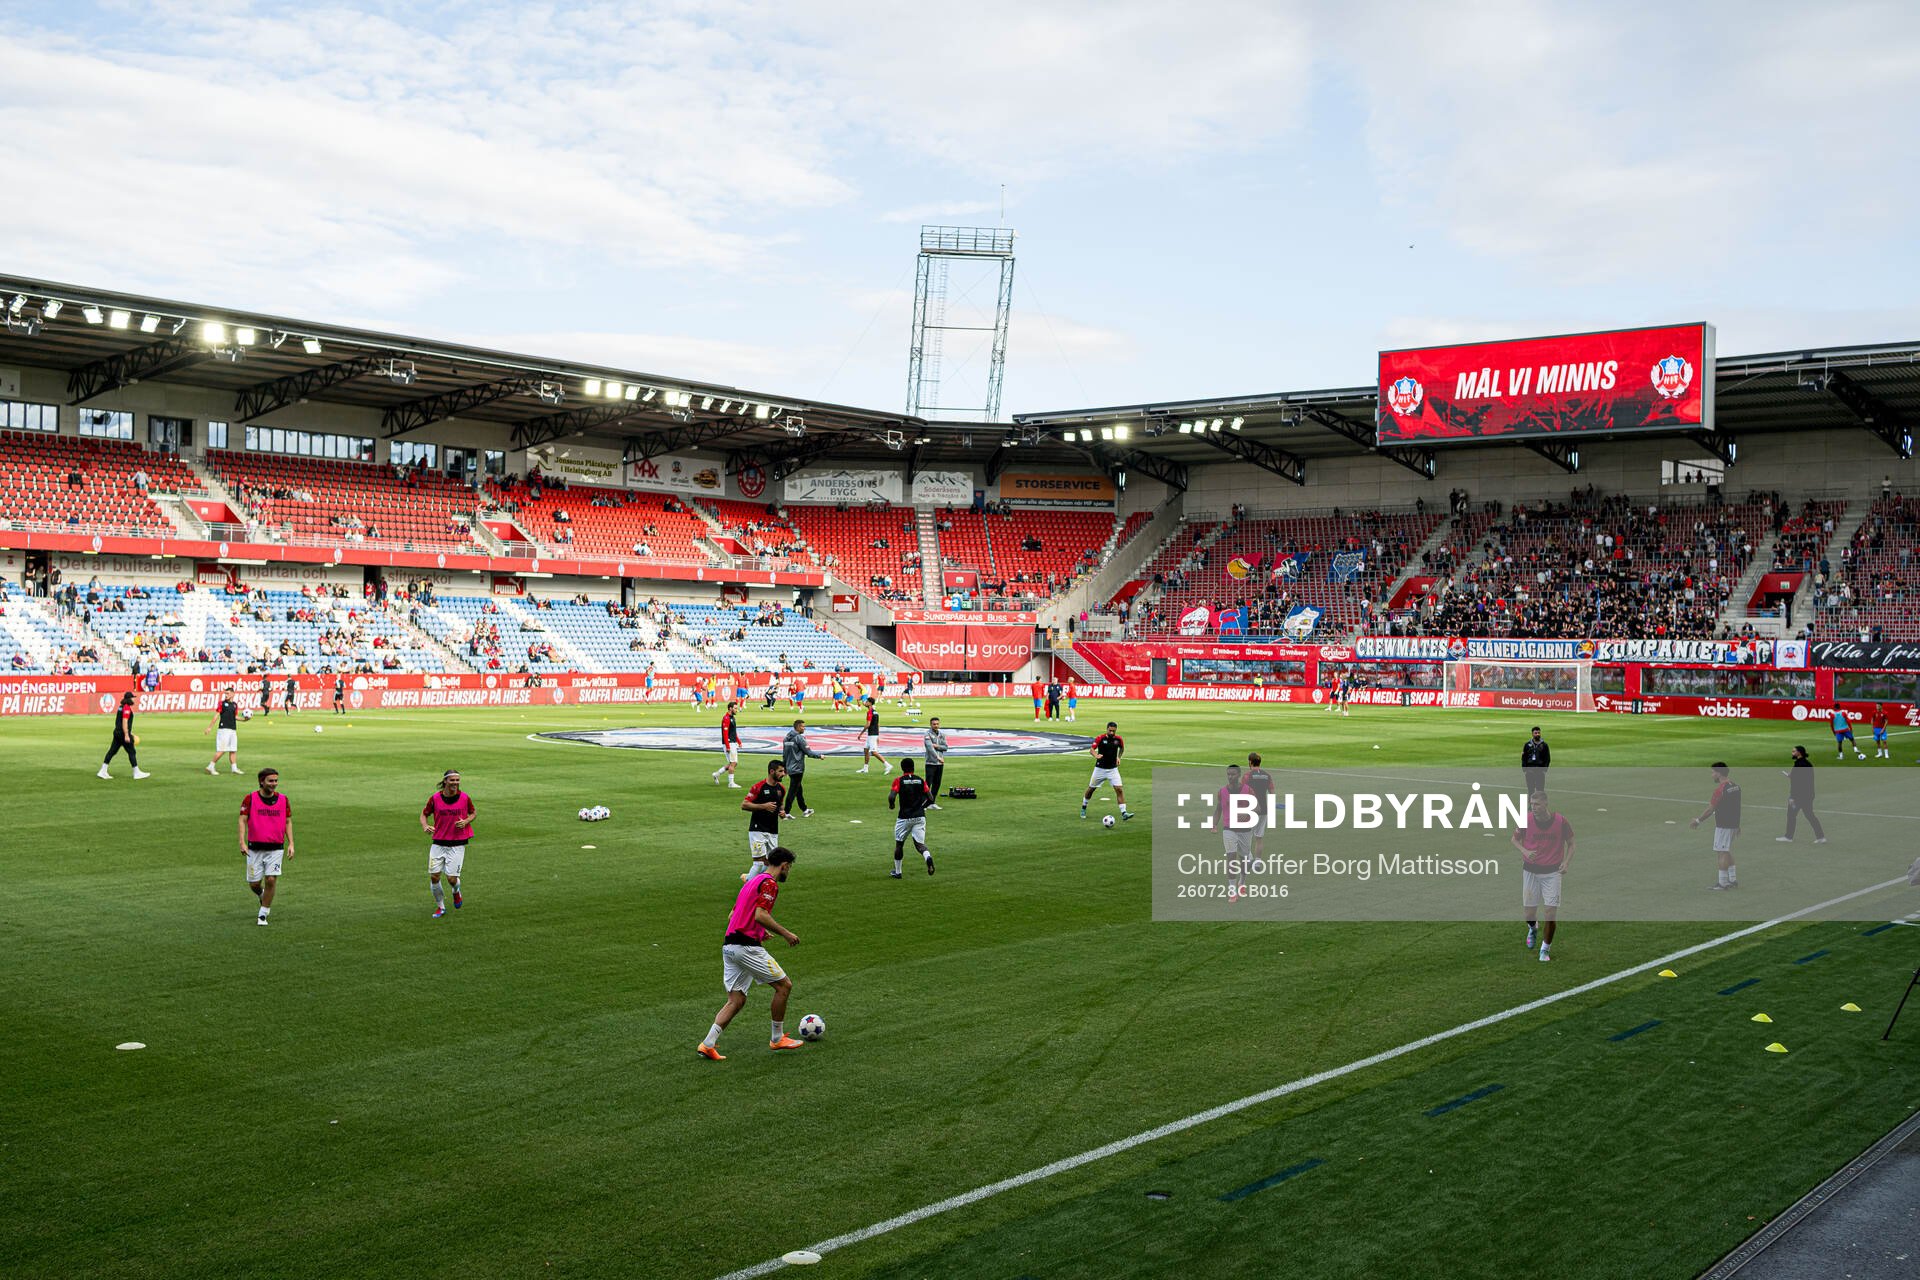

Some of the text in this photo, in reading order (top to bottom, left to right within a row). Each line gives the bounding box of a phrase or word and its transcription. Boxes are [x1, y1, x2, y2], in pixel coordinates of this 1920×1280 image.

[1455, 360, 1618, 400] MÅL VI MINNS
[564, 466, 601, 477] Helsingborg
[634, 459, 659, 479] MAX
[810, 479, 877, 488] ANDERSSONS
[1015, 479, 1100, 490] STORSERVICE
[830, 488, 857, 496] BYGG
[60, 556, 181, 574] Det är bultande
[302, 567, 328, 579] och
[902, 640, 1028, 658] letusplay group
[1320, 646, 1351, 659] Carlsberg
[1357, 638, 1448, 658] CREWMATES
[1468, 639, 1573, 658] SKÅNEPÅGARNA
[1599, 640, 1727, 661] KOMPANIET
[1813, 642, 1864, 660] Vila
[1870, 644, 1881, 658] i
[368, 676, 388, 687] Solid
[441, 676, 460, 687] Solid
[381, 688, 531, 706] SKAFFA MEDLEMSKAP PÅ HIF.SE
[579, 688, 610, 702] SKAFFA
[668, 686, 679, 701] PÅ
[1093, 684, 1103, 697] PÅ
[1104, 686, 1127, 698] HIF.SE
[1167, 686, 1291, 701] SKAFFA MEDLEMSKAP PÅ HIF.SE
[1372, 691, 1433, 705] MEDLESKAP
[1451, 692, 1480, 705] HIF.SE
[2, 694, 65, 713] PÅ HIF.SE
[139, 693, 185, 711] SKAFFA
[1502, 696, 1573, 709] letusplay group
[1698, 702, 1749, 717] vobbiz
